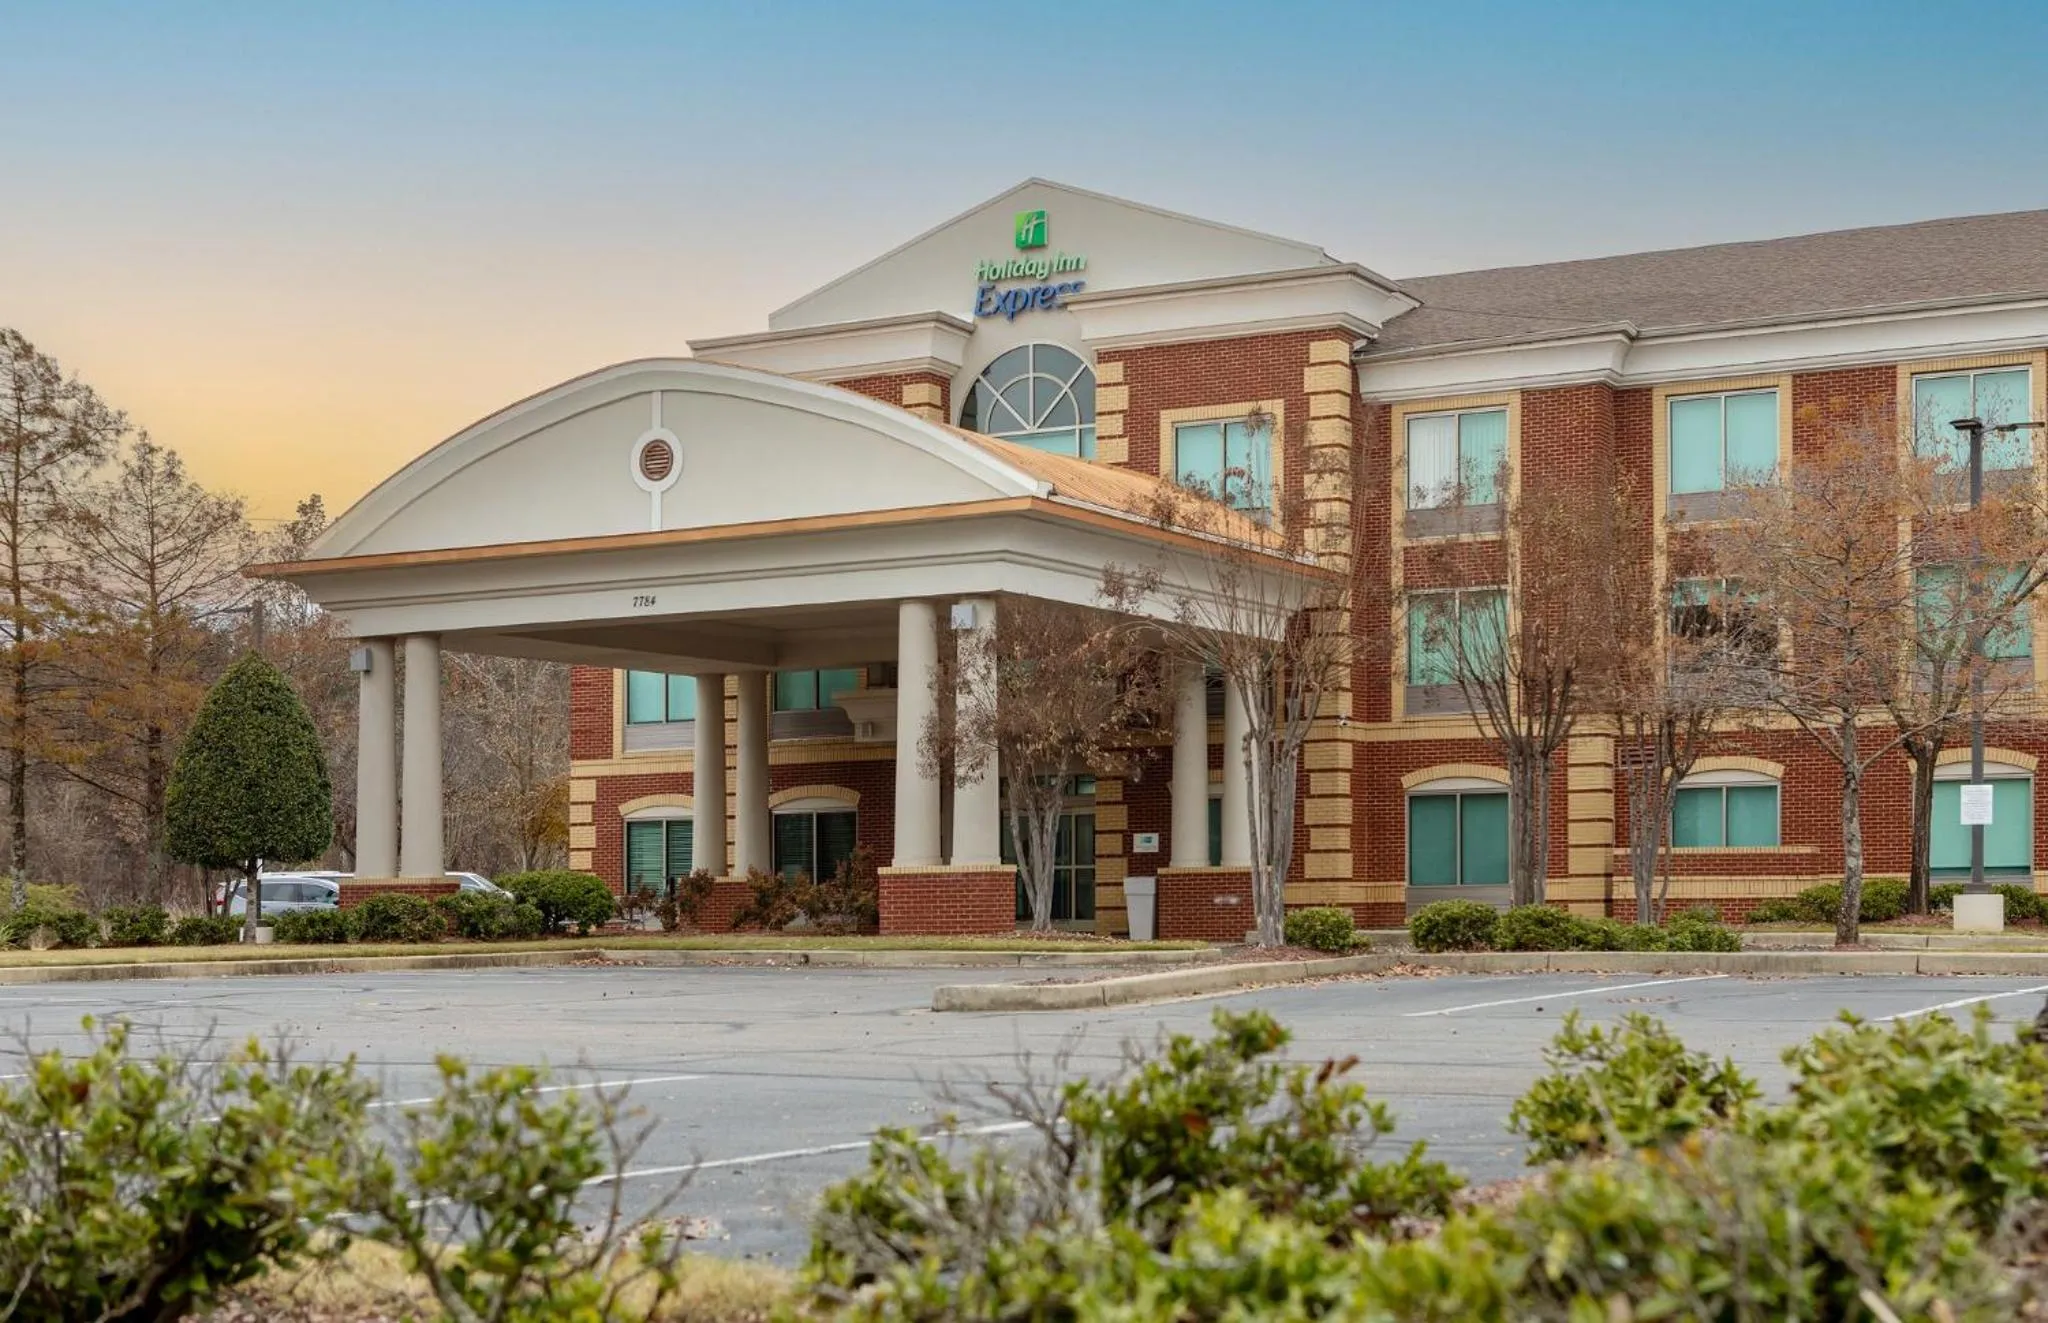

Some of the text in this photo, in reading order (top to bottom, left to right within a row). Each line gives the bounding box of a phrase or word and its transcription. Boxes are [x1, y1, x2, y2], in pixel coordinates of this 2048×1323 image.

[974, 252, 1087, 281] Holiday Inn
[632, 595, 656, 607] 7784
